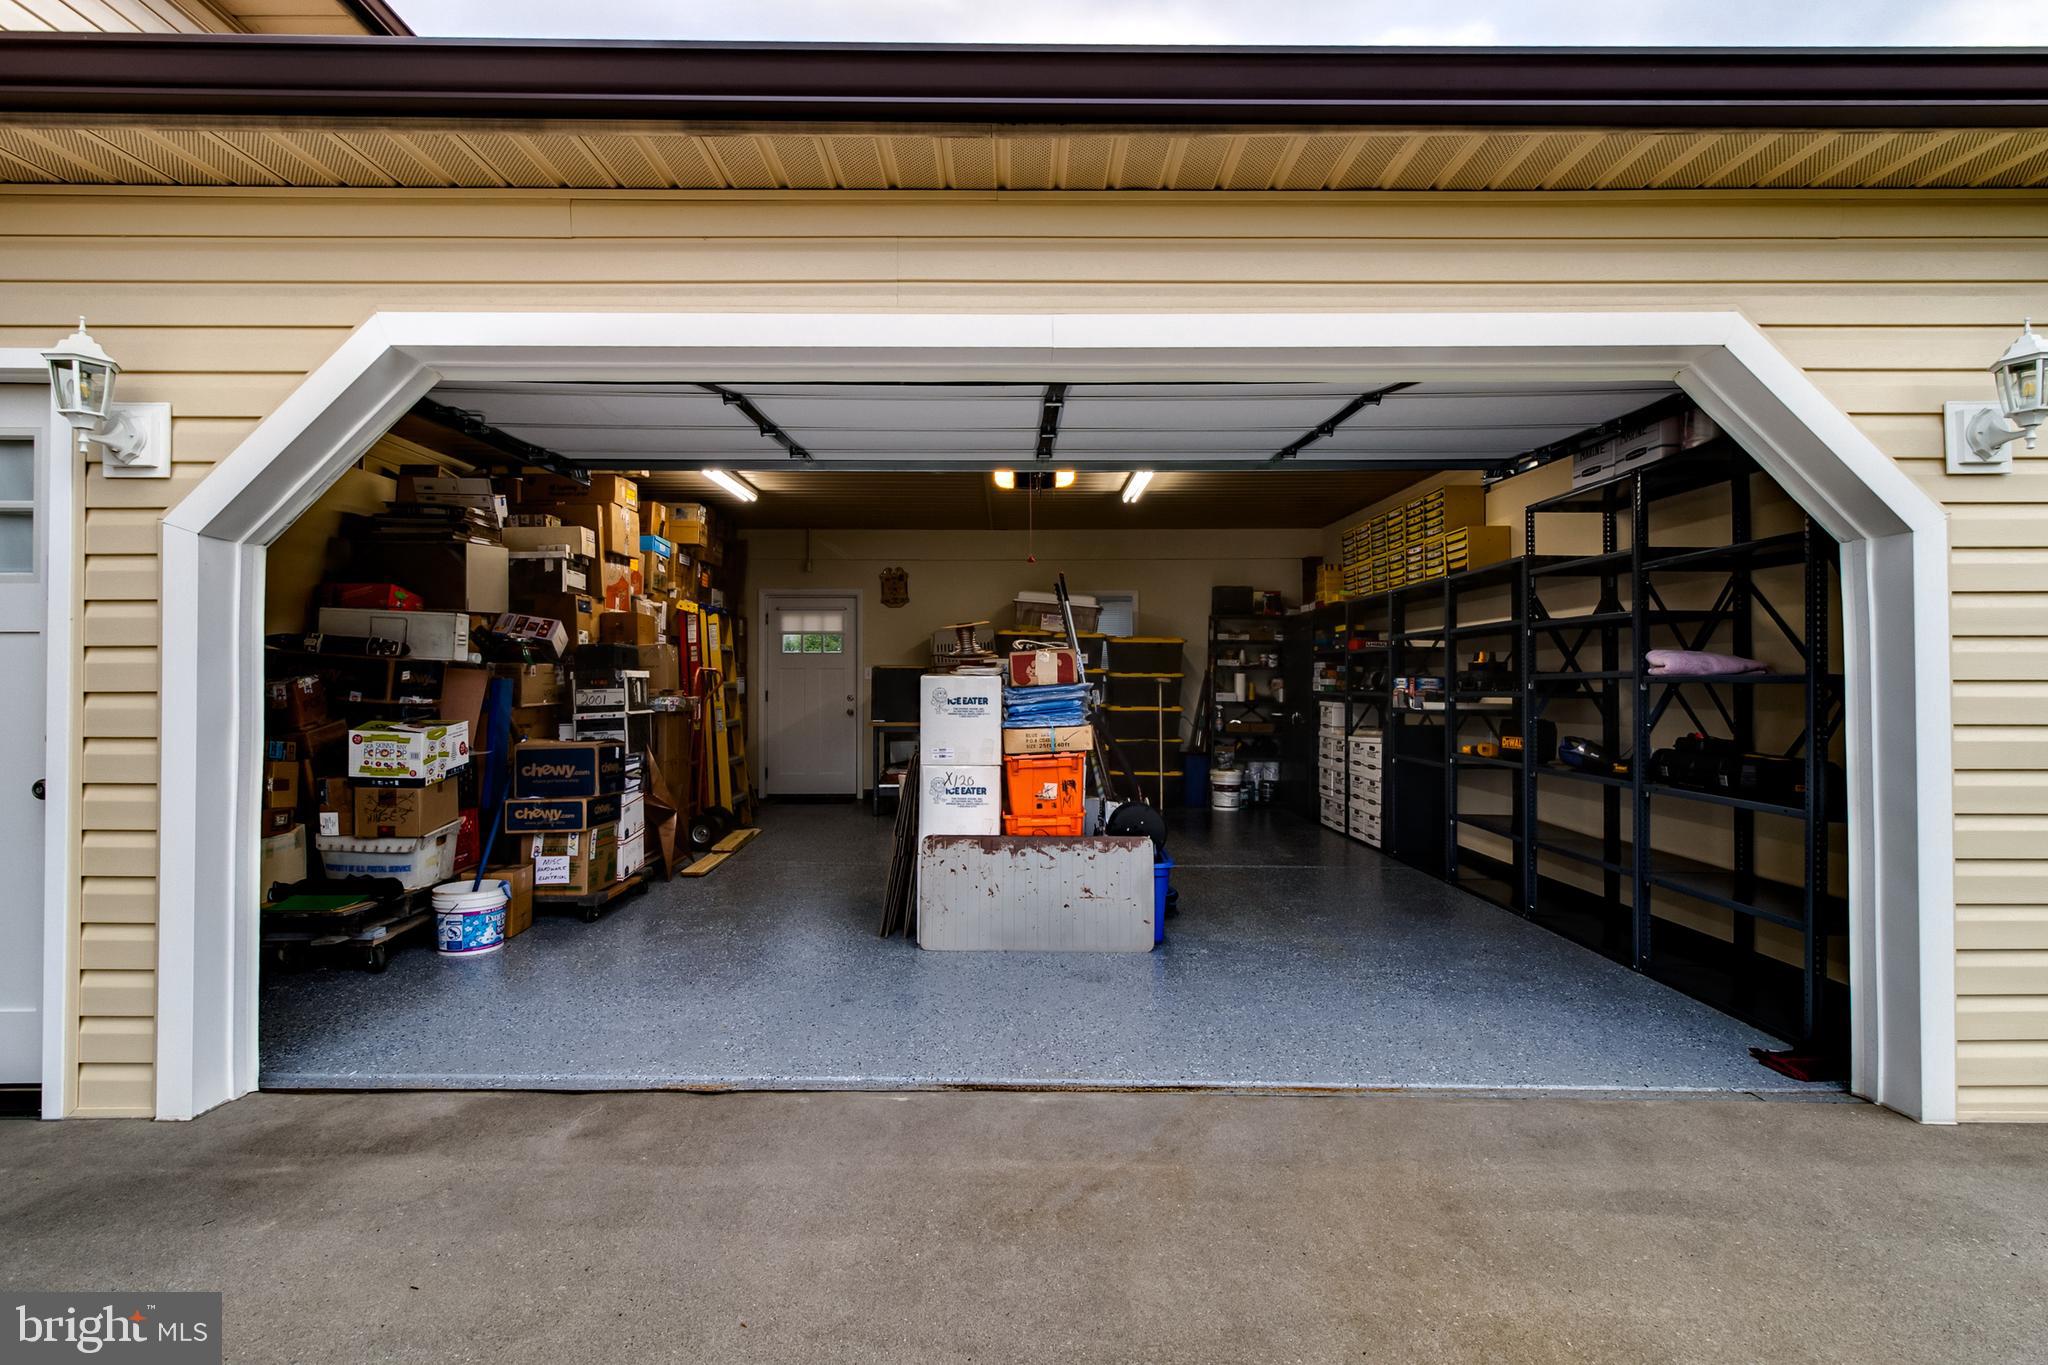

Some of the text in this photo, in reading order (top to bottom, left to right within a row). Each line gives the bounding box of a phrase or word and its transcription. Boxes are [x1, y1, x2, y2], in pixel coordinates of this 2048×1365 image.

[581, 694, 607, 705] 2001
[947, 697, 988, 705] ICE EATER
[375, 749, 395, 757] POP
[521, 763, 591, 779] chewy.com
[945, 787, 987, 795] ICE EATER
[514, 807, 576, 822] chewy.com
[325, 864, 347, 872] PROPERTY
[367, 865, 387, 873] POSTAL
[388, 864, 412, 873] SERVICE
